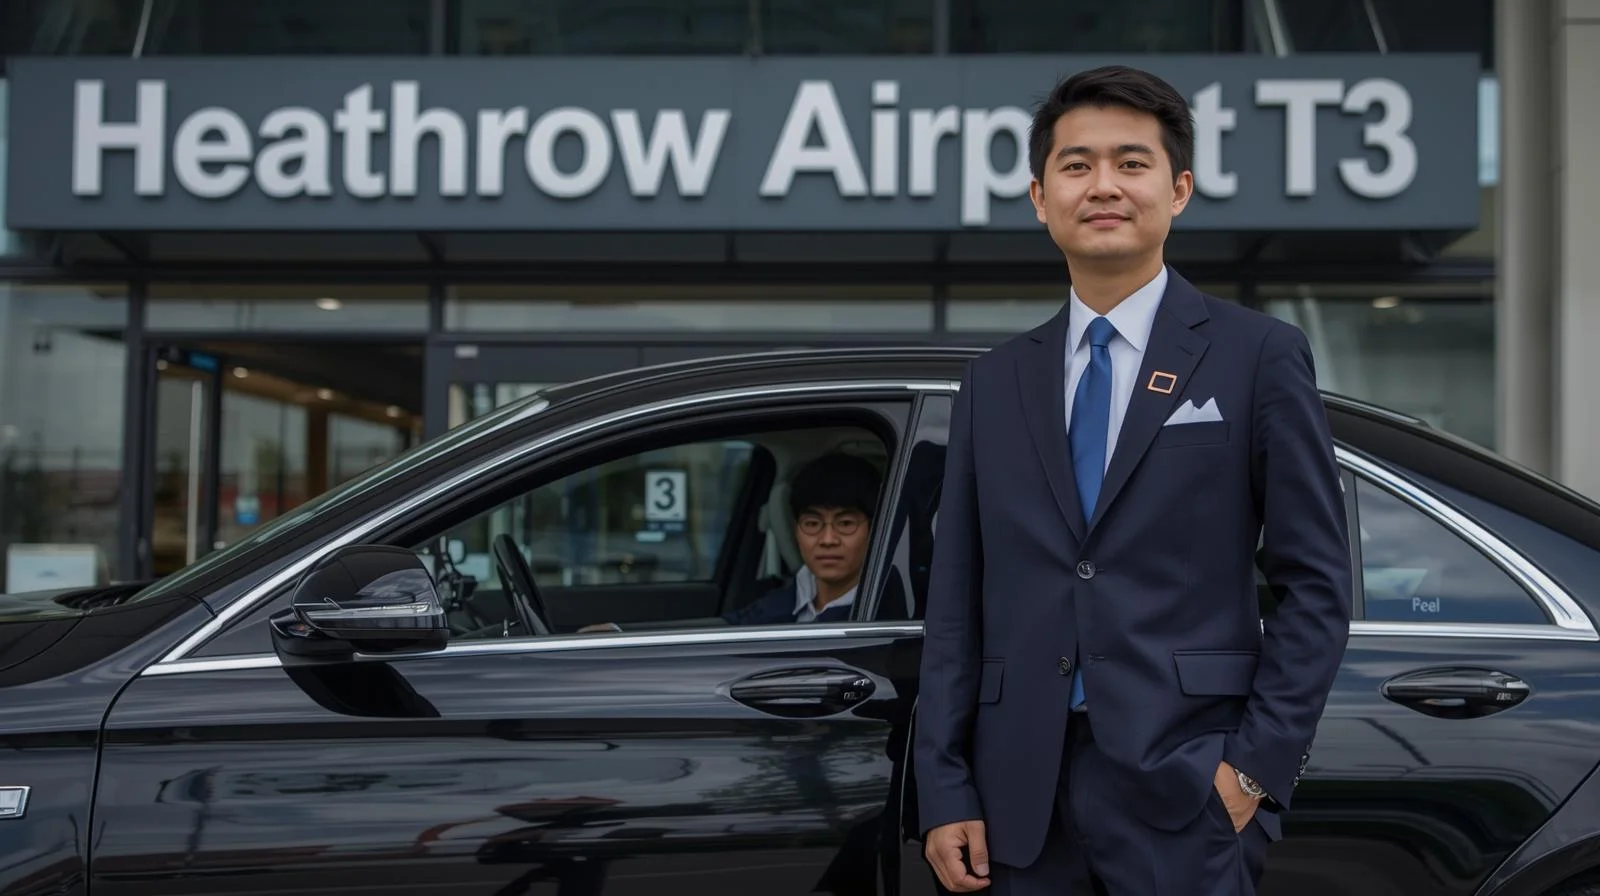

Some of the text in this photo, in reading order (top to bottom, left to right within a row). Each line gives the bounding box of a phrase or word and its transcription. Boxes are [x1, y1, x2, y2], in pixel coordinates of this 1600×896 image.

[72, 77, 1418, 226] Heathrow Airpt T3
[654, 476, 676, 511] 3
[1412, 597, 1440, 613] Peel
